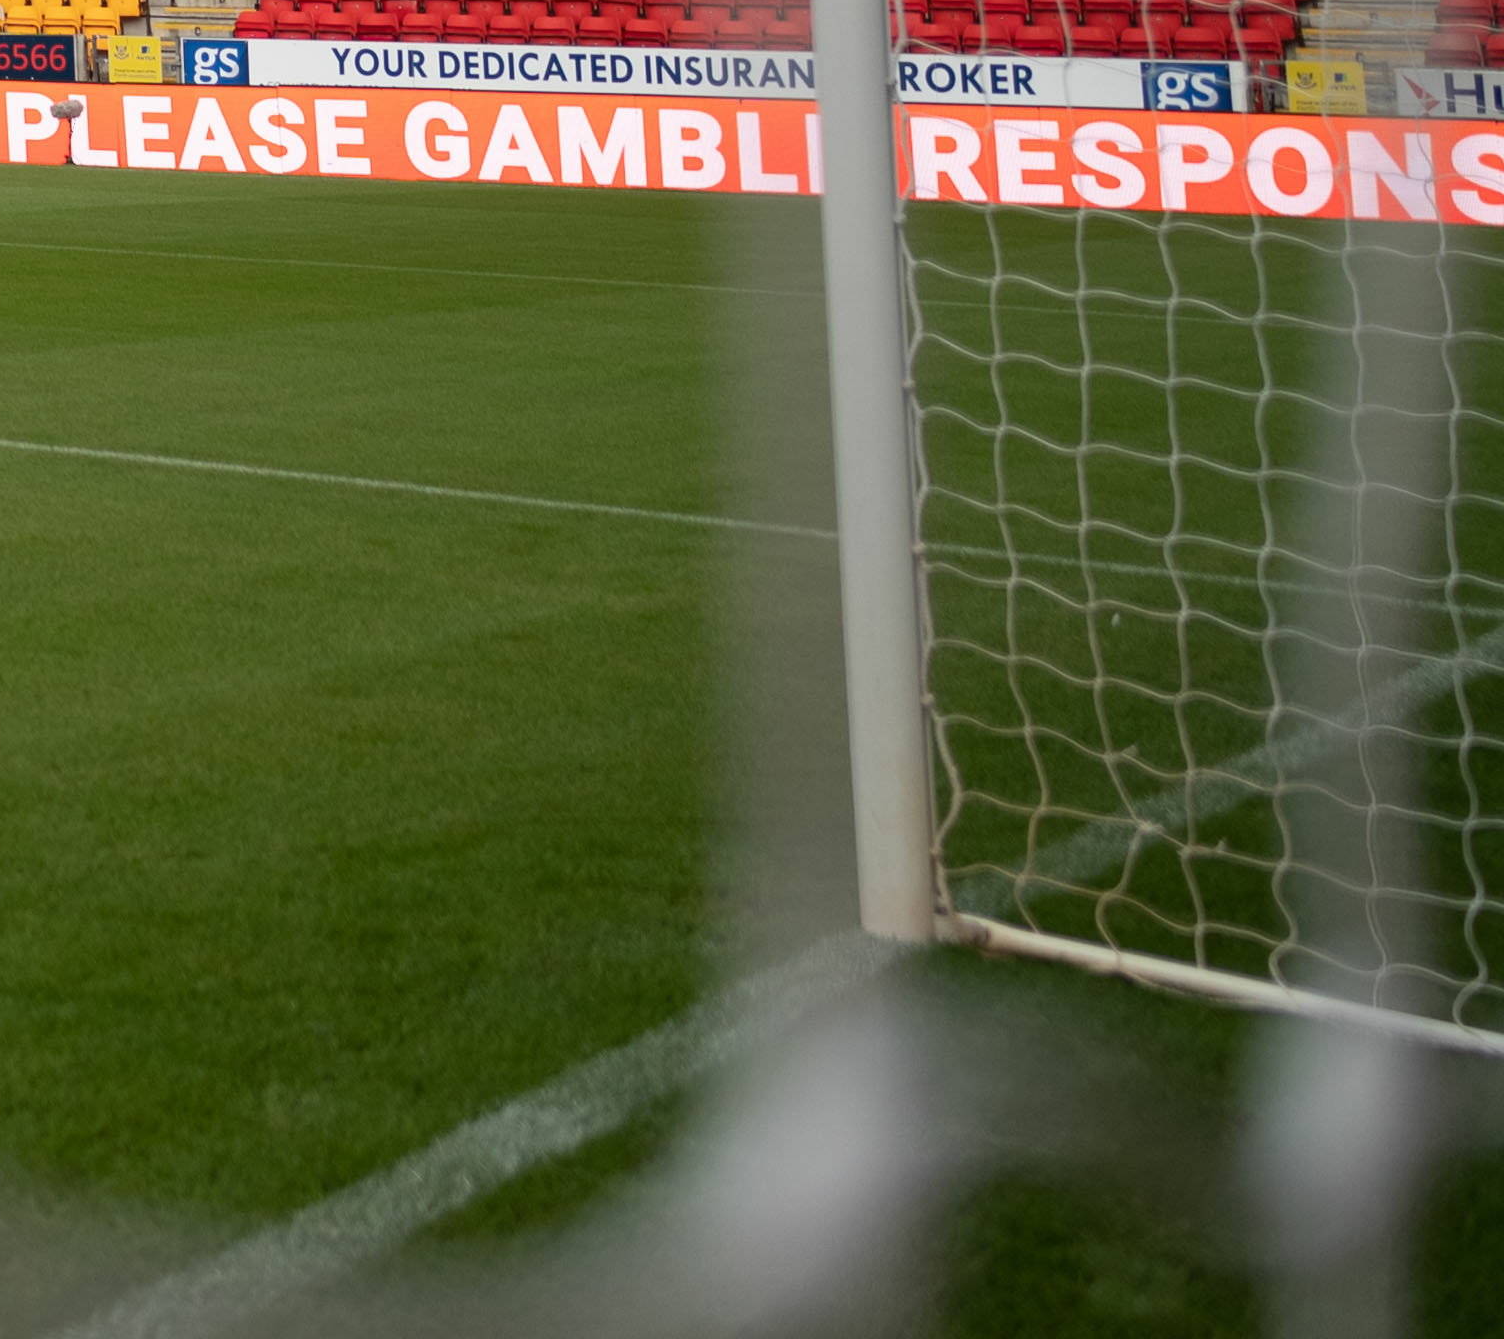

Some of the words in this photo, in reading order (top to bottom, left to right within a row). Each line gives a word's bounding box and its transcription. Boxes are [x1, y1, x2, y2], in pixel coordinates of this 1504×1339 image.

[194, 47, 240, 85] gs
[332, 47, 426, 80] YOUR
[439, 51, 634, 85] DEDICATED
[5, 91, 372, 176] PLEASE
[404, 100, 823, 195] GAMBL
